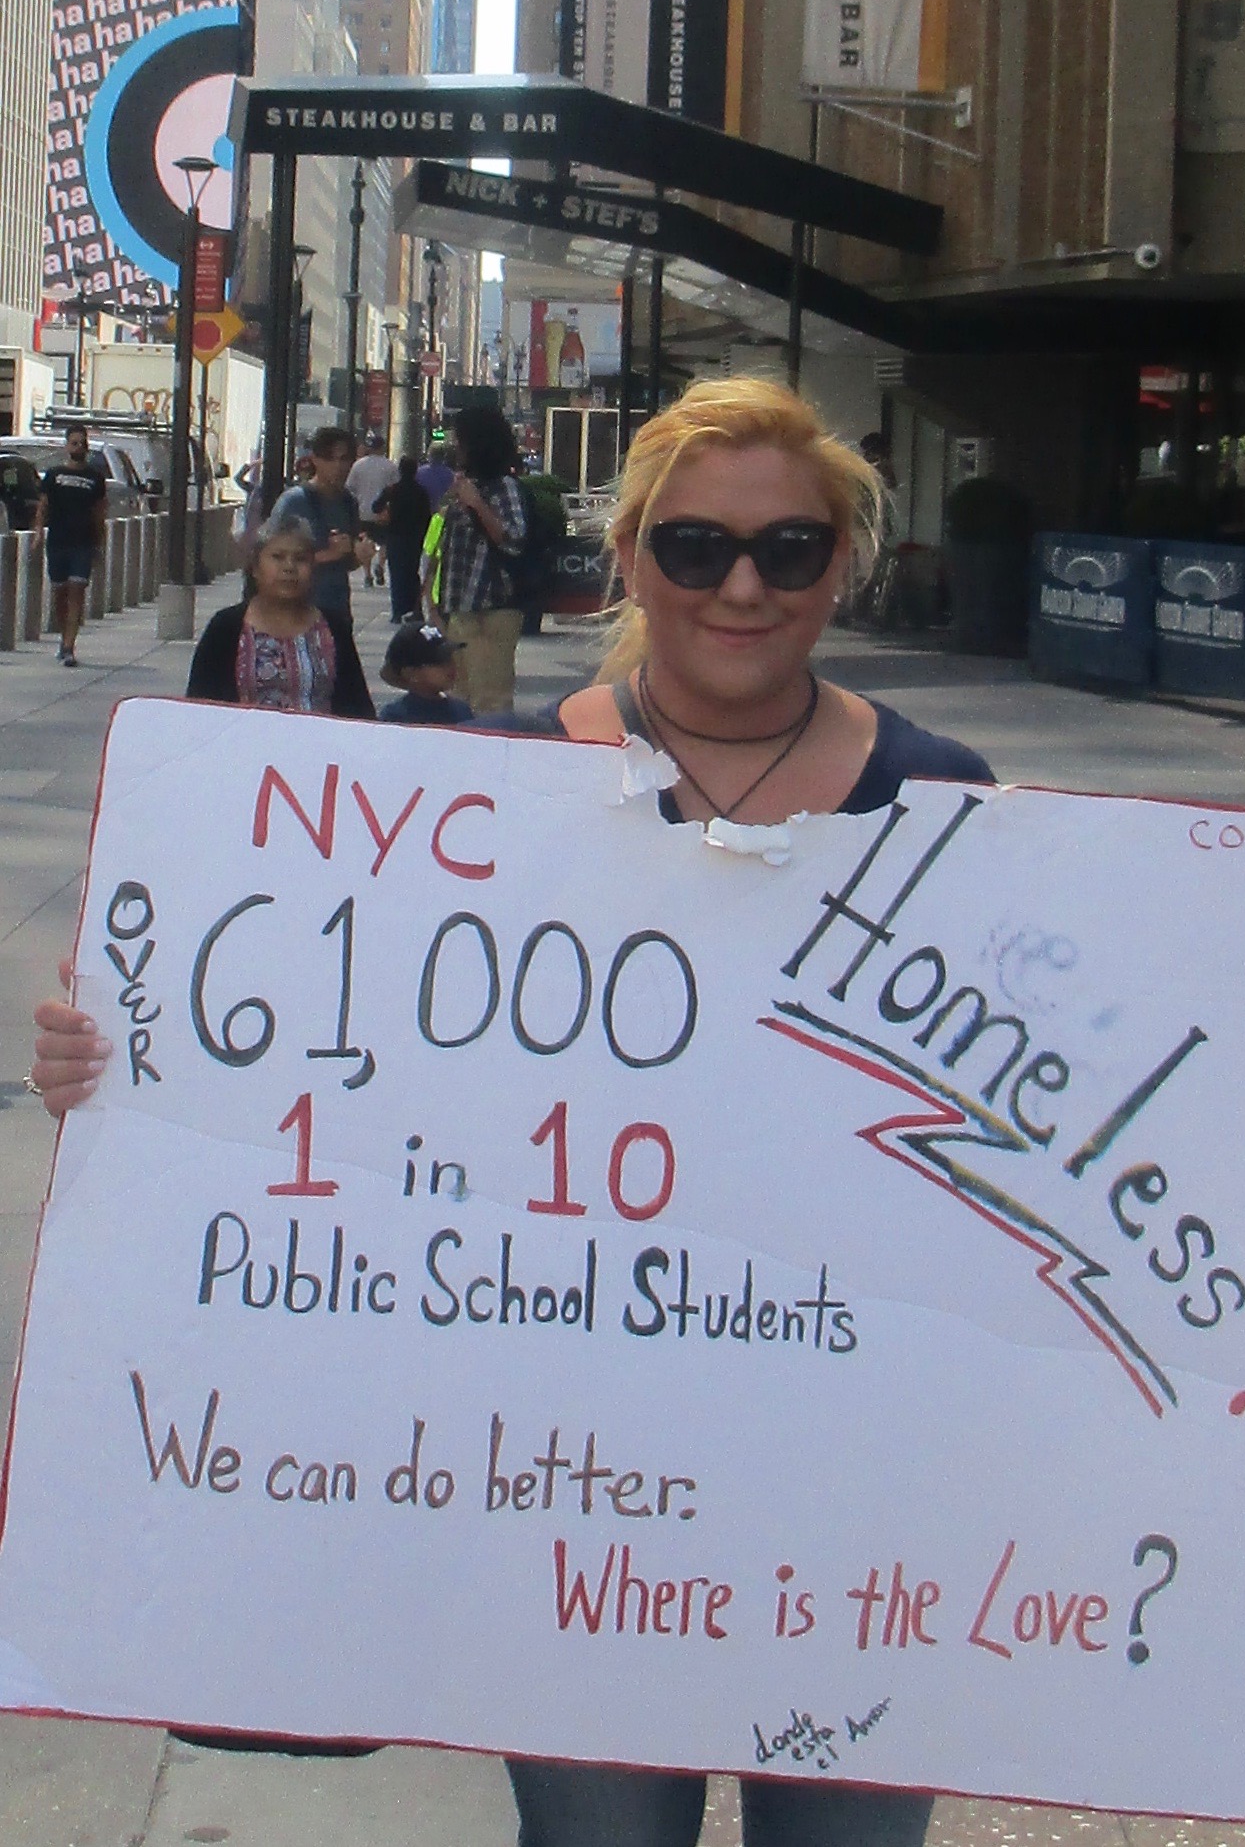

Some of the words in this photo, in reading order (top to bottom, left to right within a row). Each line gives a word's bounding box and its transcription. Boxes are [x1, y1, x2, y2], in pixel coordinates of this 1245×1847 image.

[839, 1, 861, 68] BAR
[266, 107, 455, 132] STEAKHOUSE
[469, 112, 487, 133] &
[503, 112, 559, 134] BAR
[443, 172, 522, 208] NICK
[560, 195, 660, 236] STEF'S
[252, 763, 495, 880] NYC
[104, 881, 161, 1085] OVER
[190, 893, 698, 1089] 61,000
[267, 1093, 340, 1196] 1
[403, 1134, 467, 1201] in
[526, 1101, 676, 1221] 10
[199, 1211, 397, 1313] Public
[420, 1228, 597, 1332] School
[622, 1247, 857, 1353] Students
[130, 1370, 242, 1493] We
[265, 1454, 356, 1503] can
[385, 1415, 454, 1508] do
[553, 1538, 734, 1640] Where
[774, 1564, 816, 1638] is
[845, 1561, 941, 1650] the
